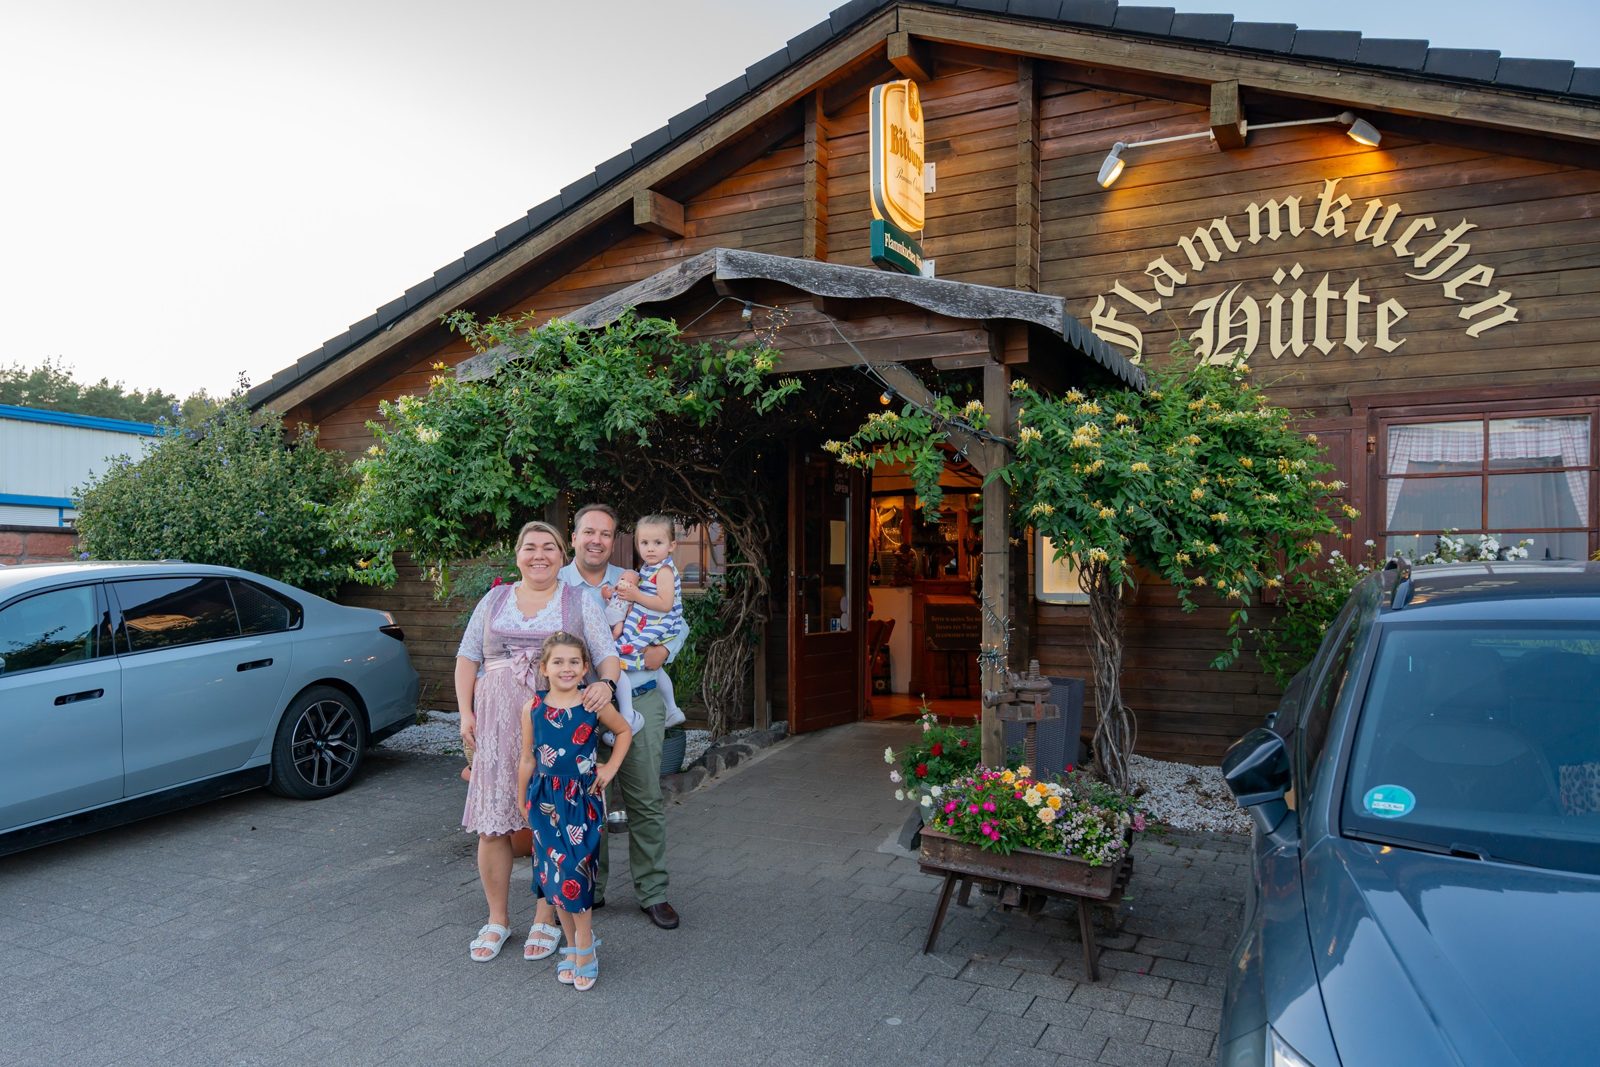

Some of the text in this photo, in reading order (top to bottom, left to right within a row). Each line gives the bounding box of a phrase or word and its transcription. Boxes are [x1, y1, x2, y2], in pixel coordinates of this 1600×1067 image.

[890, 123, 924, 176] Bitburg
[1090, 177, 1519, 365] Flammkuchen
[1188, 262, 1408, 366] Hütte
